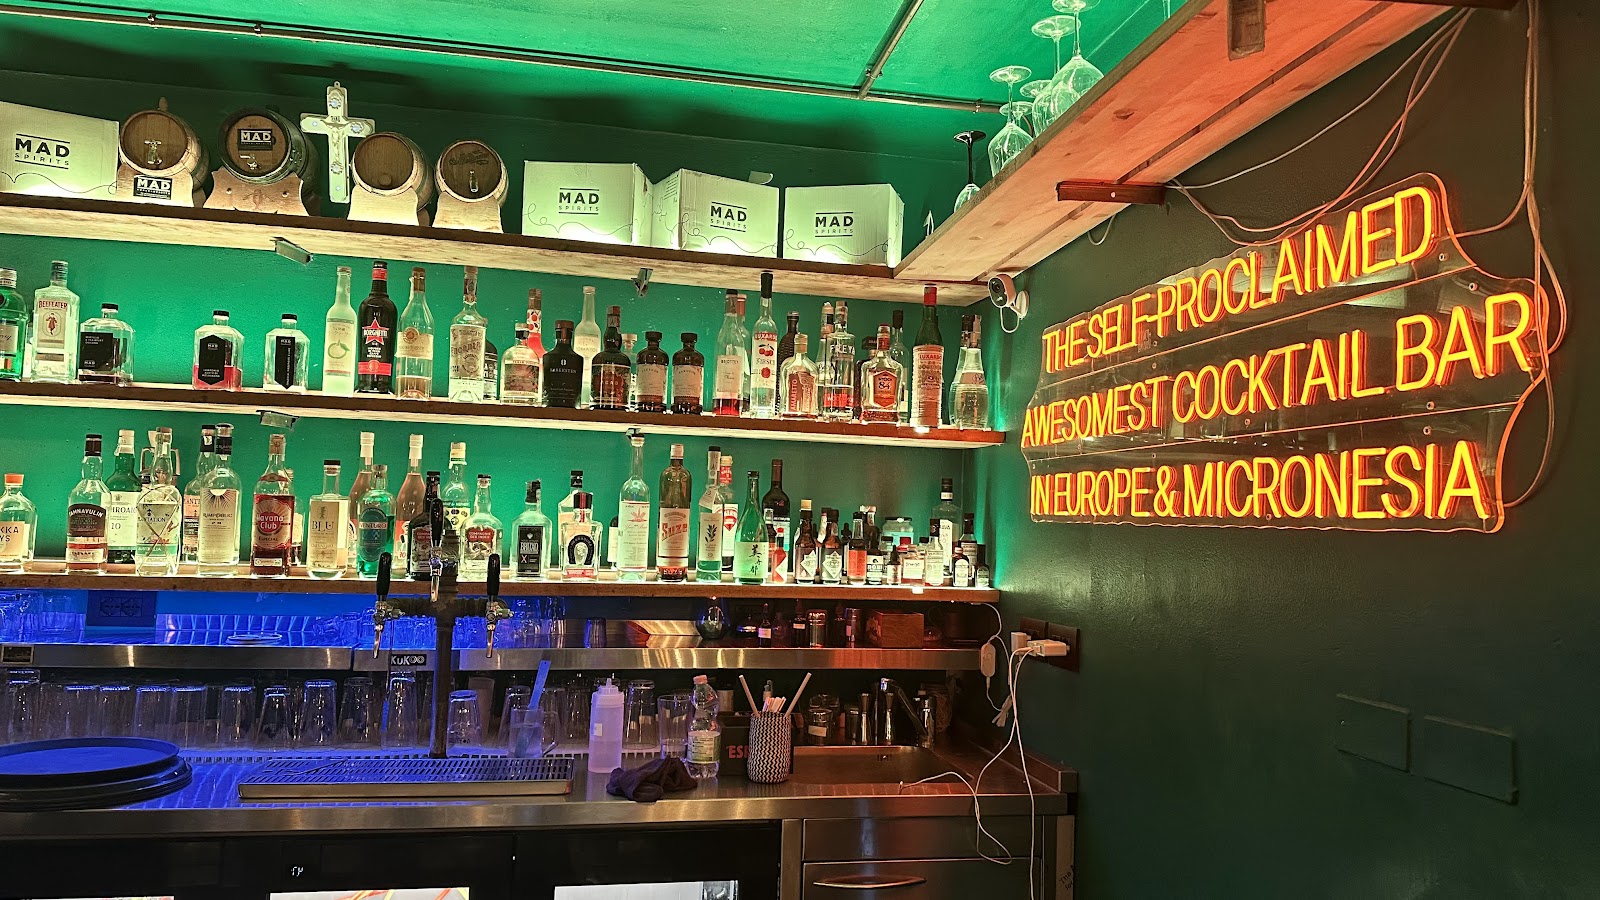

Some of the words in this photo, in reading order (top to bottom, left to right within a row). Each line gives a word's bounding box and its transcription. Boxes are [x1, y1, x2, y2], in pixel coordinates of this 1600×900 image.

[241, 132, 271, 141] MAD
[15, 137, 70, 158] MAD
[15, 152, 69, 166] SPIRITS
[137, 178, 170, 190] MAD
[559, 191, 599, 204] MAD
[558, 204, 599, 212] SPIRITS
[710, 204, 747, 222] MAD
[710, 219, 747, 229] SPIRITS
[815, 215, 854, 227] MAD
[815, 227, 854, 235] SPIRITS
[1042, 330, 1088, 374] THE
[1087, 186, 1437, 359] SELF-PROCLAIMED
[38, 300, 68, 310] BEEFEATER
[754, 332, 777, 341] LUXARD
[1021, 375, 1173, 449] AWESOMEST
[1172, 328, 1386, 424] COCKTAIL
[1396, 292, 1535, 392] BAR
[878, 382, 892, 390] 84
[1030, 473, 1052, 516] IN
[1054, 467, 1152, 518] EUROPE
[1153, 464, 1176, 517] &
[1183, 440, 1490, 521] MICRONESIA
[257, 512, 284, 523] Havana
[260, 521, 277, 529] Club
[311, 520, 334, 532] BLU
